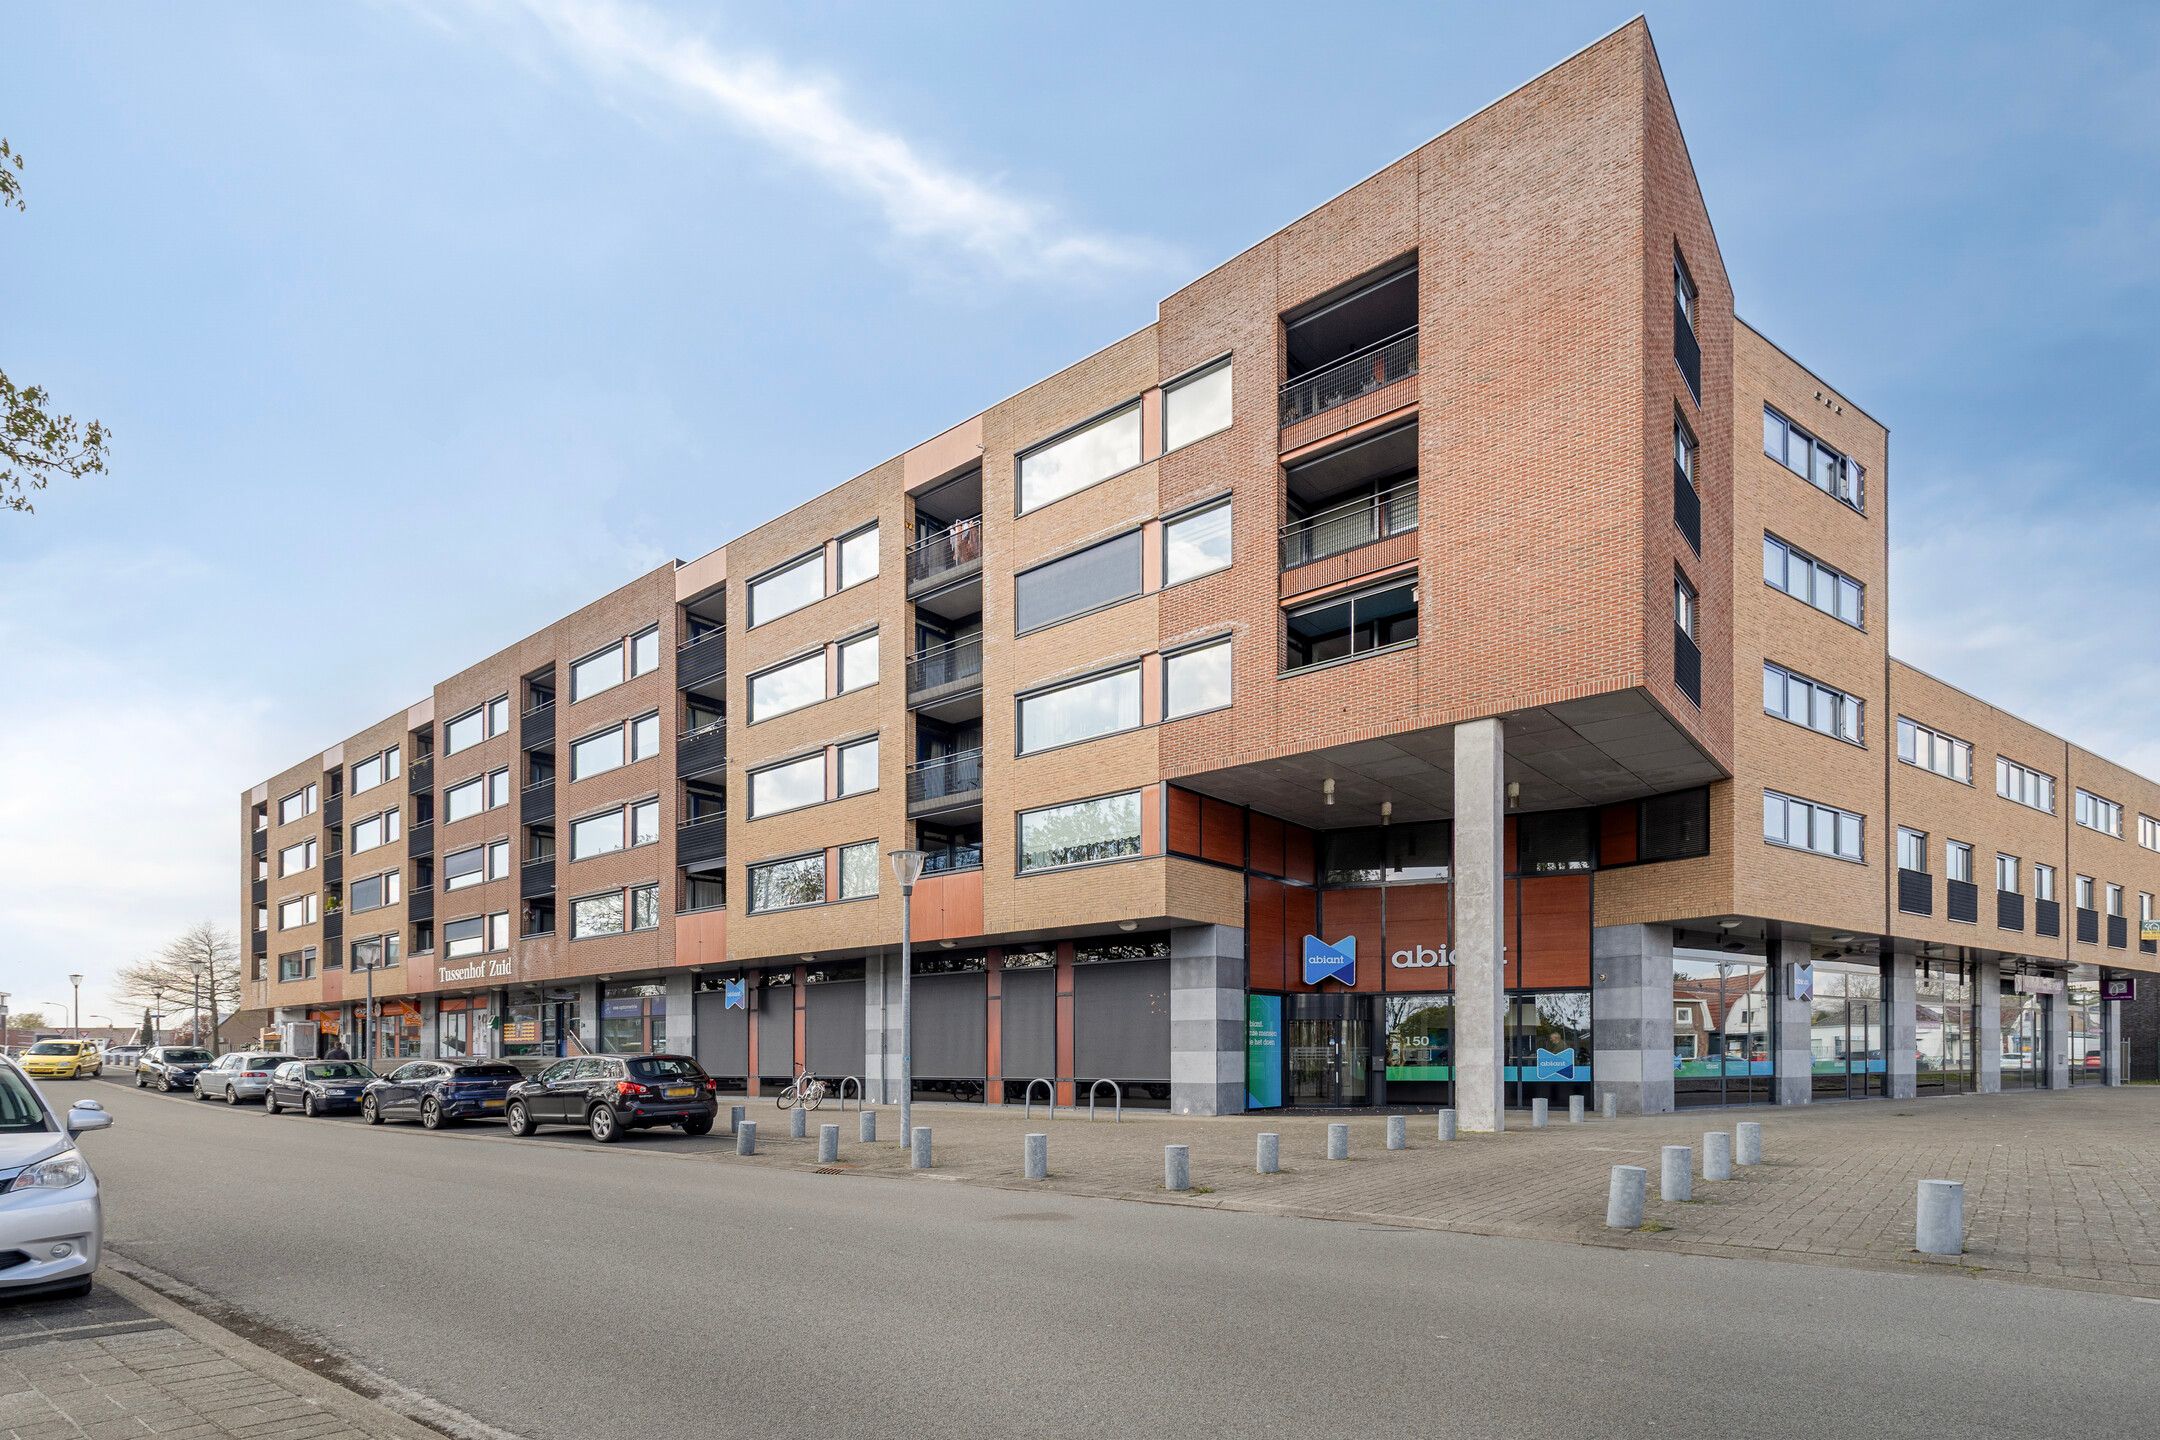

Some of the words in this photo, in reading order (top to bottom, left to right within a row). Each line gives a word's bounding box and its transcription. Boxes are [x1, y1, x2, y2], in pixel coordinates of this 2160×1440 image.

[1308, 955, 1345, 964] abiant
[1391, 944, 1507, 968] abi
[438, 960, 486, 983] Tussenhof
[489, 957, 512, 976] Zuid
[1405, 1036, 1430, 1046] 150
